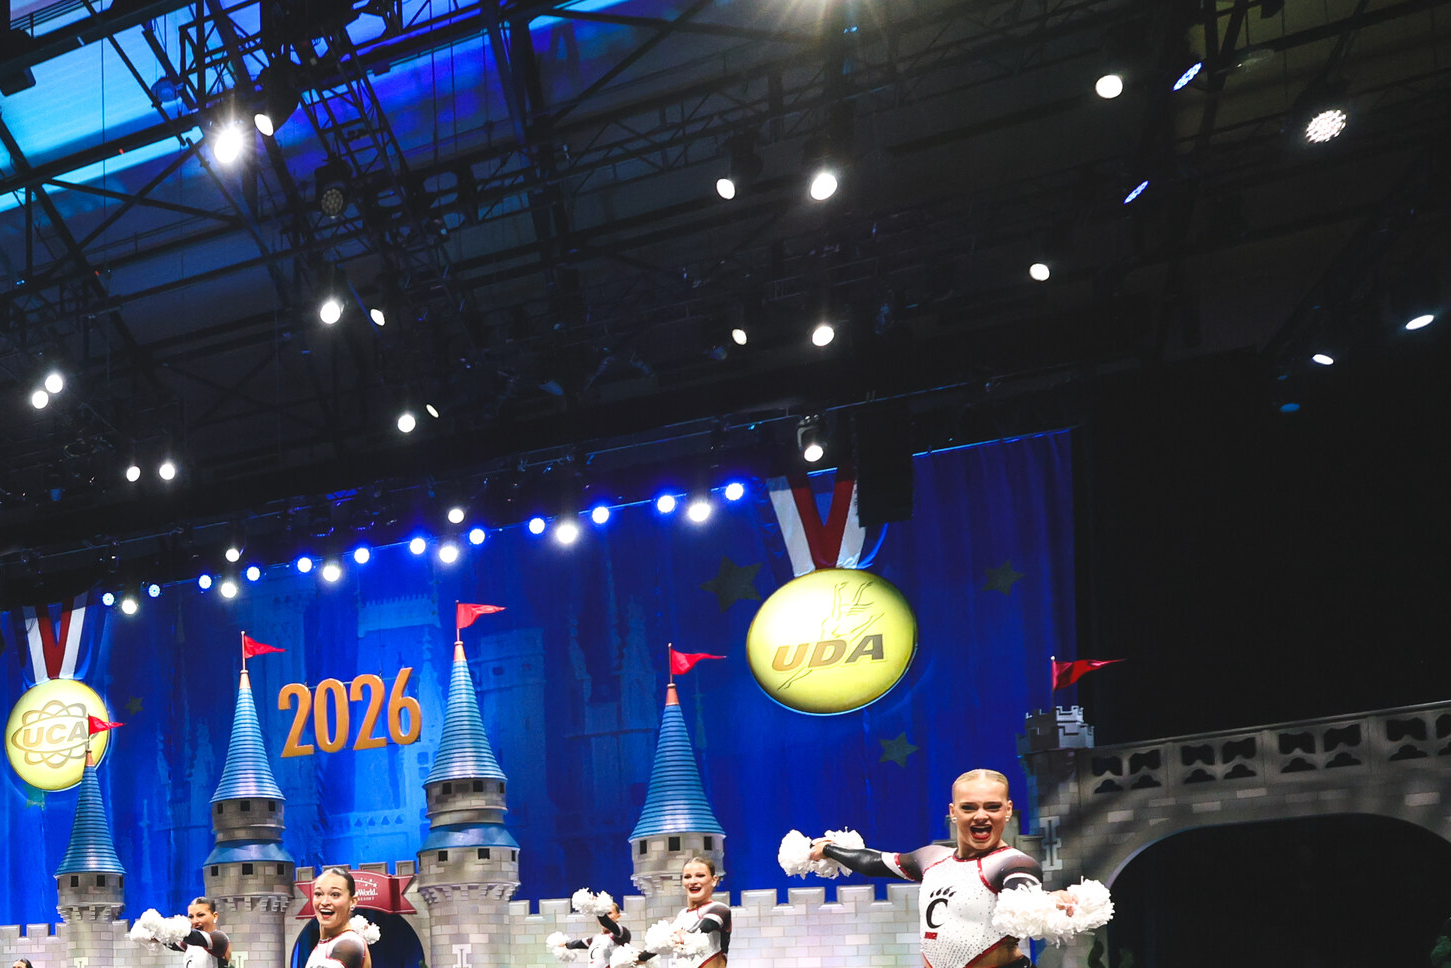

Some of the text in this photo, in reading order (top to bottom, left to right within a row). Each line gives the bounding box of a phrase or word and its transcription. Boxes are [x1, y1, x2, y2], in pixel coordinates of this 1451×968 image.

[772, 633, 885, 672] UDA
[278, 667, 423, 758] 2026
[23, 721, 88, 748] UCA
